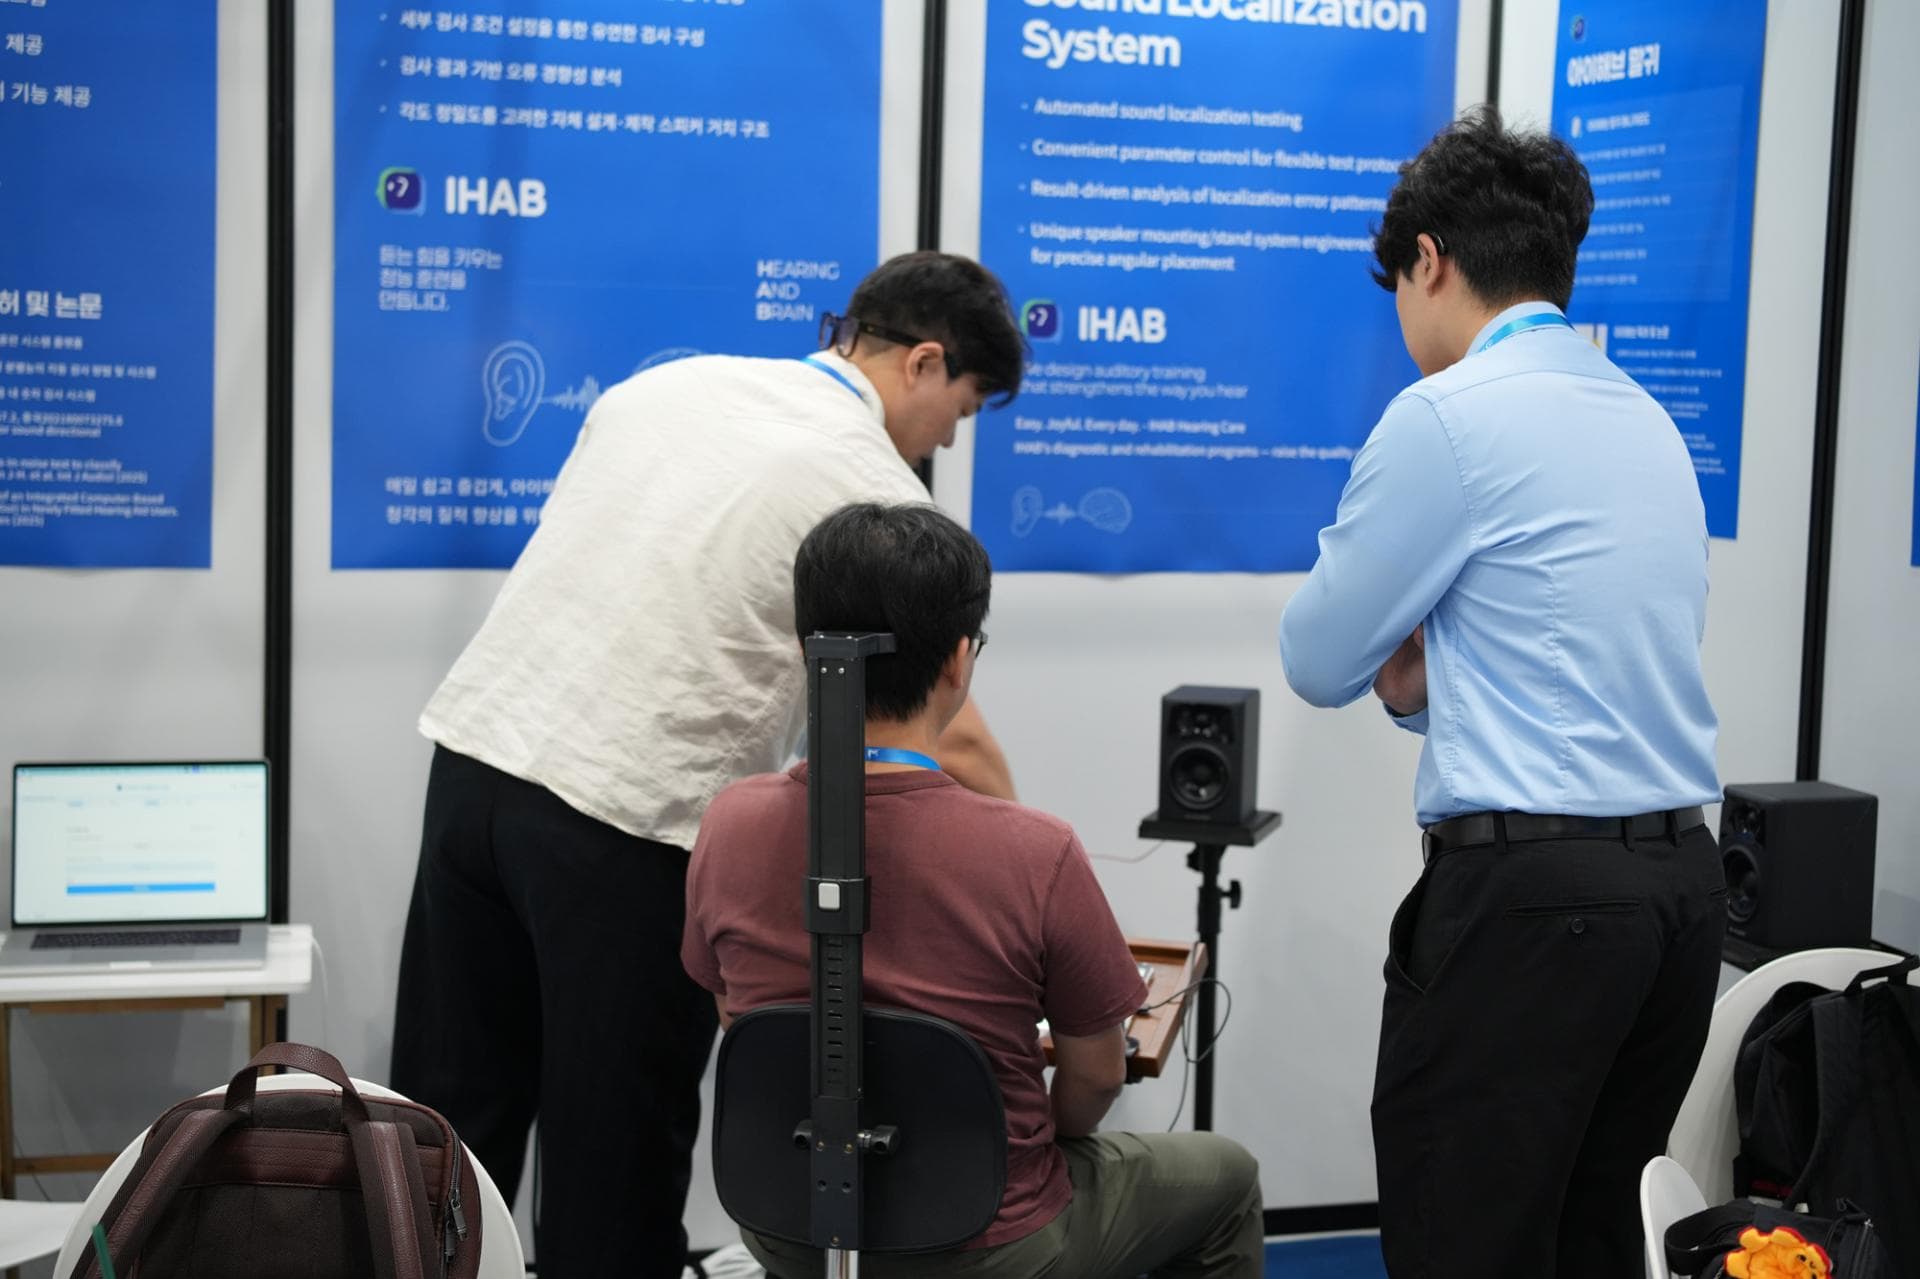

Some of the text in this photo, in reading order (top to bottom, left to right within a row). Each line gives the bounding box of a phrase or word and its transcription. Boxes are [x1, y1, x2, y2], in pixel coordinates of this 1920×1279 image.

[6, 34, 43, 56] 제공
[1022, 18, 1182, 69] System
[54, 85, 91, 108] 제공
[1034, 99, 1303, 132] Automated sound localization testing
[1033, 139, 1118, 158] Convenient
[1120, 146, 1196, 163] parameter
[1199, 149, 1250, 166] control
[1252, 150, 1274, 167] for
[1275, 151, 1326, 170] flexible
[1328, 155, 1354, 172] test
[444, 176, 547, 217] IHAB
[1132, 186, 1190, 206] analysis
[1193, 188, 1209, 204] of
[1210, 188, 1292, 208] localization
[1294, 193, 1329, 209] error
[1031, 222, 1083, 241] Unique
[1085, 225, 1139, 244] speaker
[1254, 233, 1300, 251] system
[757, 260, 840, 280] HEARING
[1032, 248, 1235, 272] for precise angular placement
[756, 282, 800, 300] AND
[757, 303, 814, 321] BRAIN
[1078, 306, 1167, 343] IHAB
